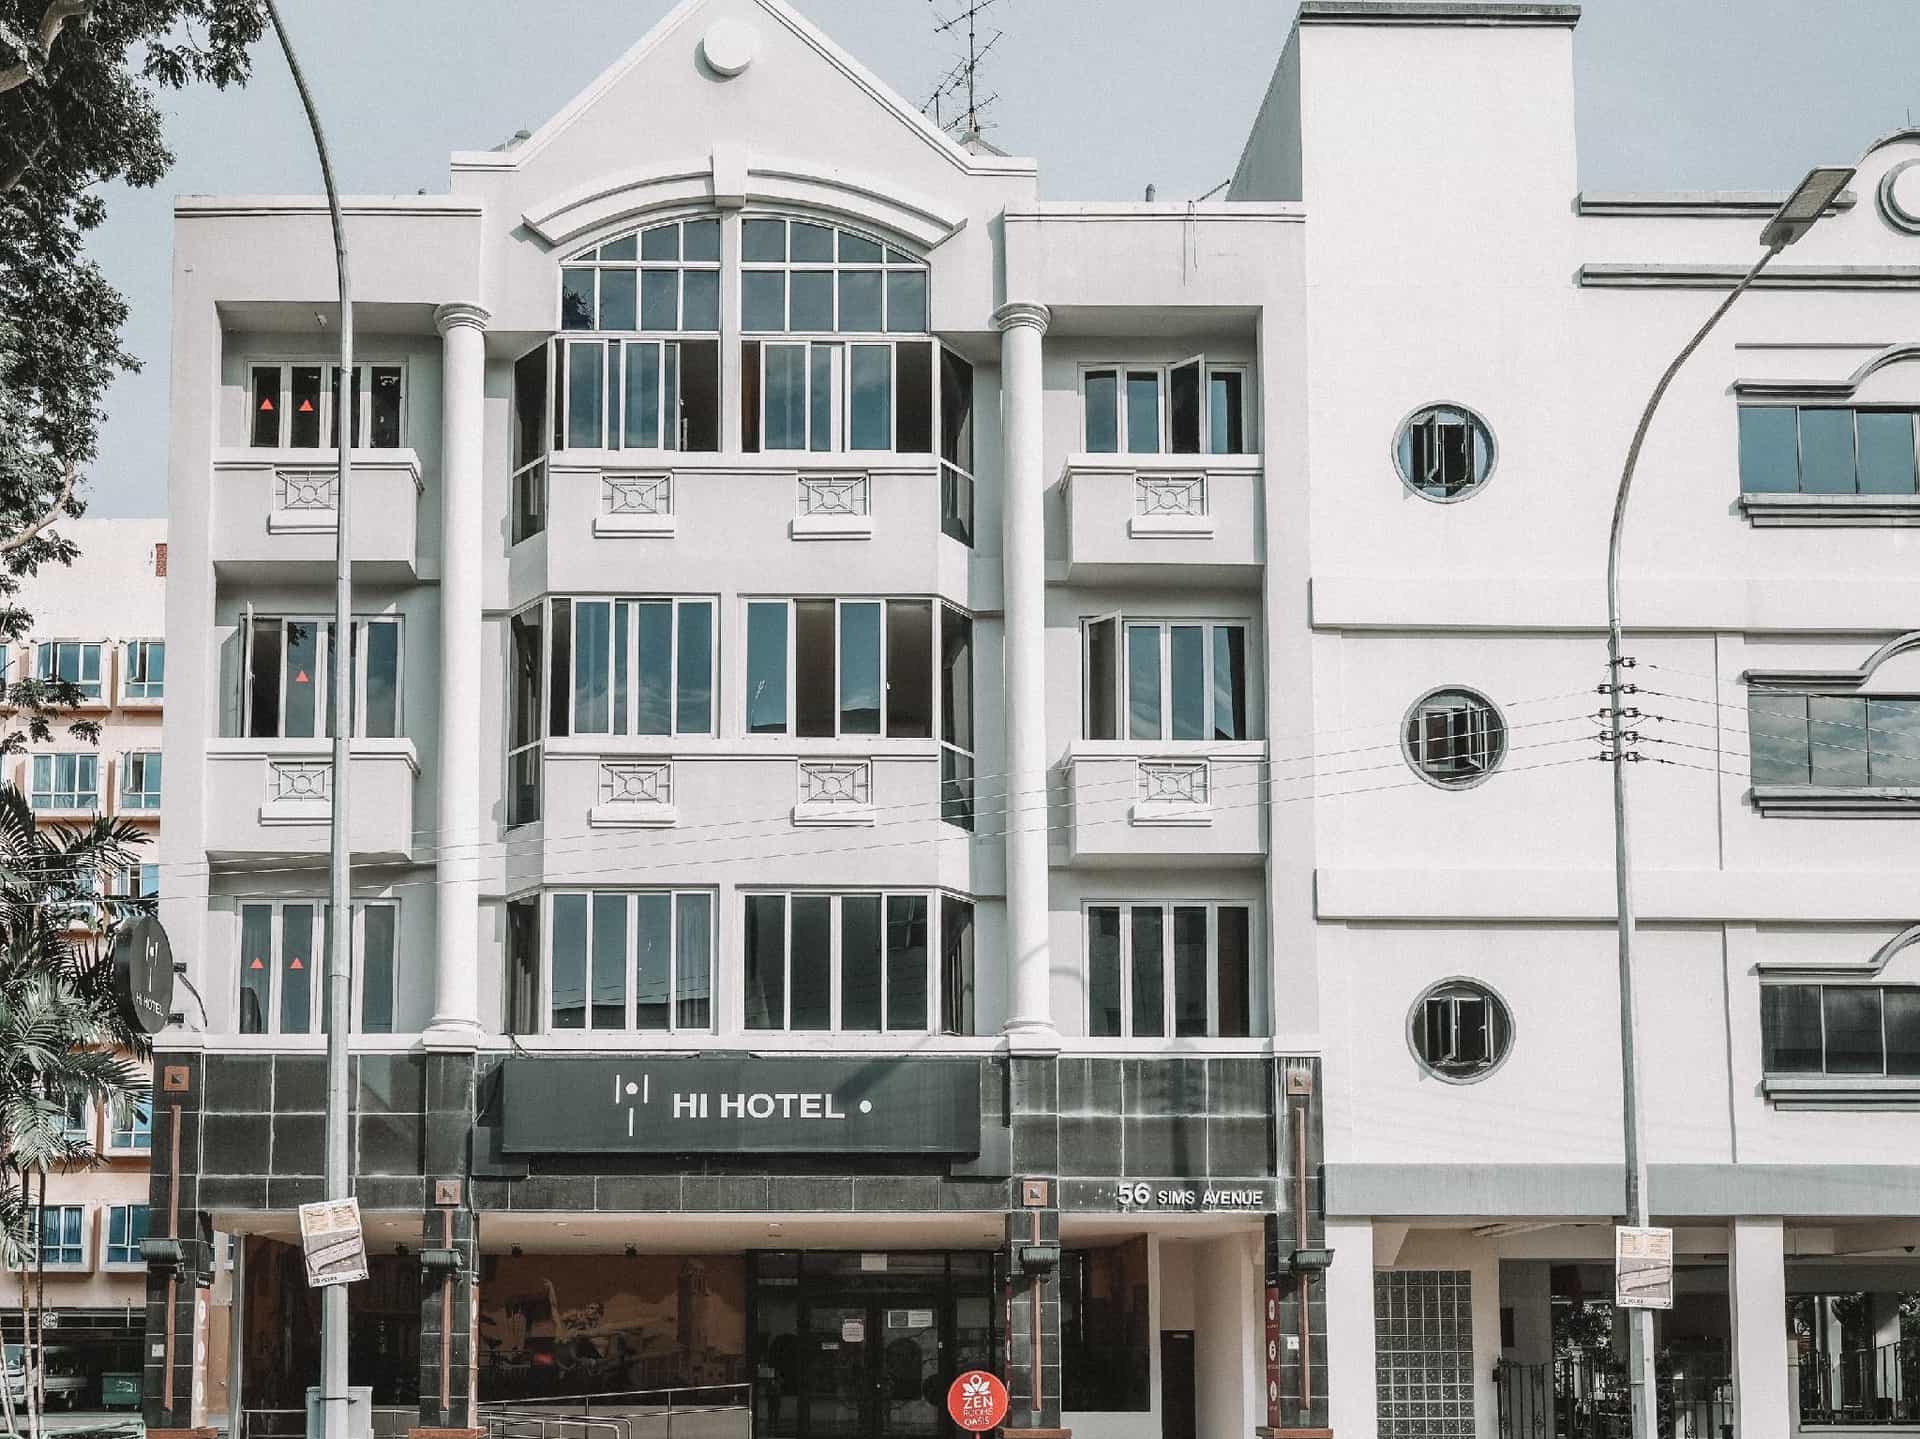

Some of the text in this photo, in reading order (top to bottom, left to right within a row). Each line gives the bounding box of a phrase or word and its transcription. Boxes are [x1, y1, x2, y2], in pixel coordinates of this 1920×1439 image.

[144, 996, 164, 1017] HOTEL
[673, 1093, 846, 1119] HI HOTEL
[1117, 1182, 1264, 1206] 56 SIMS AVENUE
[962, 1396, 994, 1409] ZEN
[963, 1408, 993, 1416] ROOMS
[963, 1416, 990, 1426] OASIS
